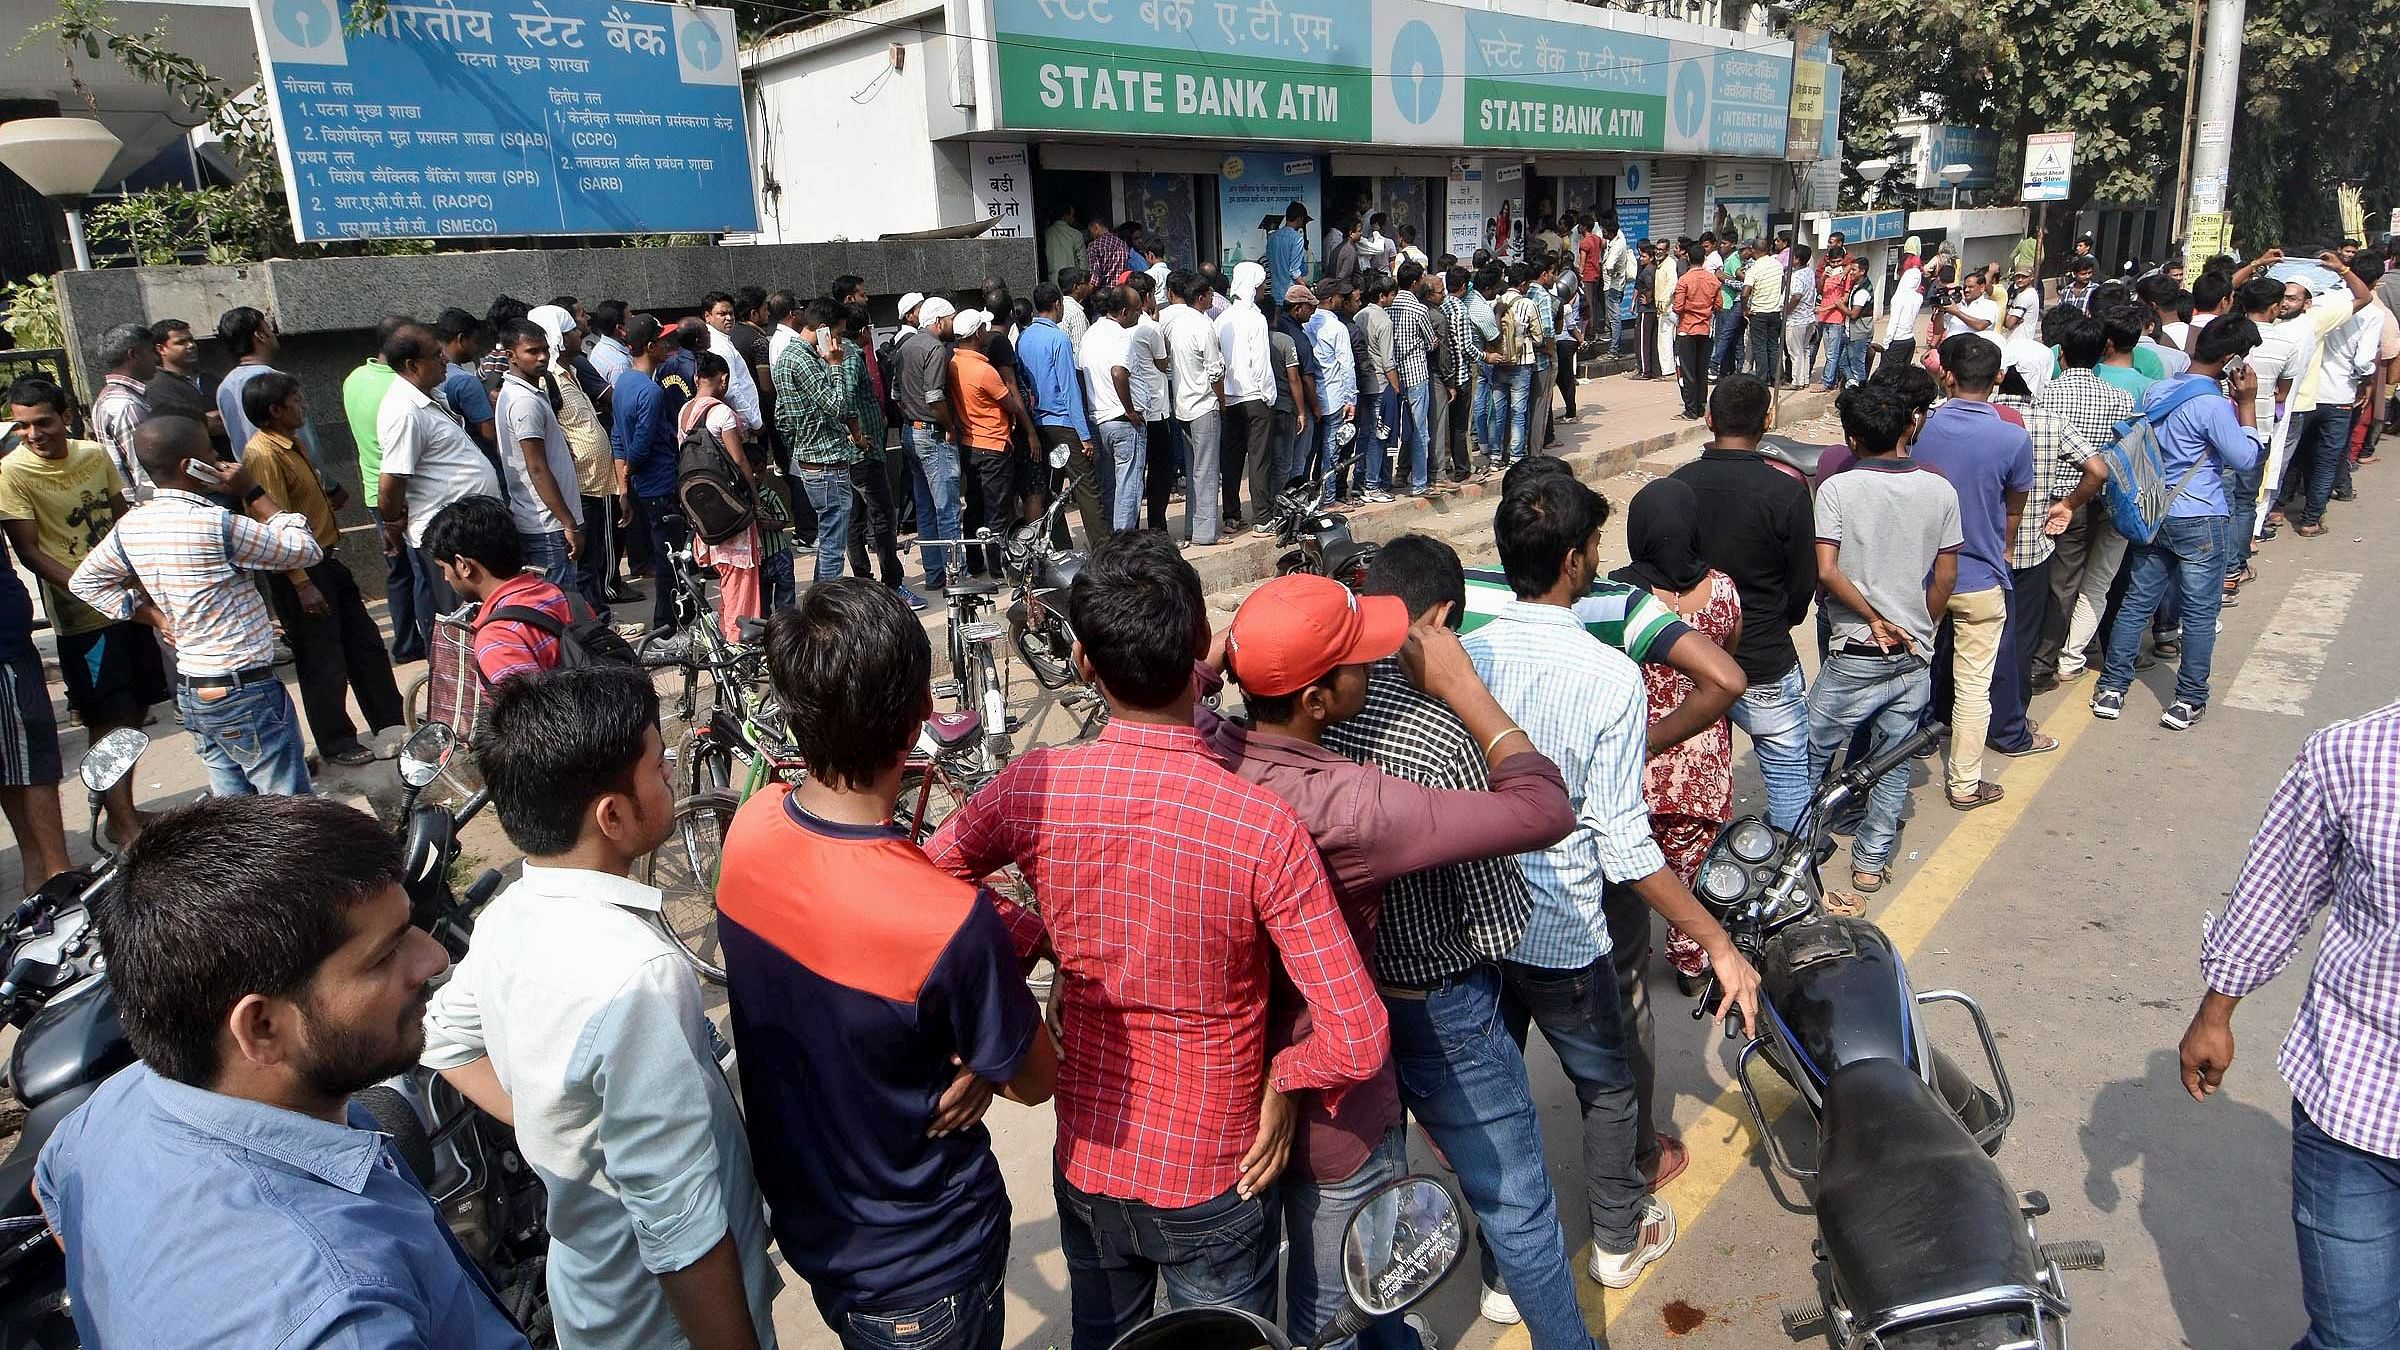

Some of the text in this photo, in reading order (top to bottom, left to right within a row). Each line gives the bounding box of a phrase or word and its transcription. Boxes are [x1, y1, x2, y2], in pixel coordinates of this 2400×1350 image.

[367, 0, 666, 56] ारतीय स्टेट बैंक
[1479, 28, 1524, 69] स्टेट
[1536, 35, 1567, 73] बैंक
[456, 51, 590, 74] पटना मुख्य शाखा
[282, 76, 354, 96] नीचला तल
[1039, 64, 1339, 122] STATE BANK ATM
[548, 87, 602, 105] द्वितीय तल
[299, 103, 422, 122] 1. पटना मुख्य शाखा
[1480, 99, 1644, 137] STATE BANK ATM
[1723, 111, 1761, 128] INTERNET
[304, 127, 318, 141] 2.
[321, 125, 383, 149] विशेषीकृत
[387, 131, 410, 148] मुद्रा
[416, 131, 458, 145] प्रशासन
[464, 132, 495, 146] शाखा
[572, 133, 617, 149] (CCPC)
[1721, 131, 1776, 149] COIN VENDING
[296, 151, 355, 165] प्रथम तल
[561, 157, 573, 170] 2.
[625, 154, 650, 170] अस्ति
[654, 155, 684, 171] प्रबंधन
[687, 158, 713, 171] शाखा
[307, 173, 321, 187] 1.
[328, 166, 365, 184] विशेष
[466, 171, 496, 184] शाखा
[503, 170, 539, 187] (SPB)
[579, 177, 623, 193] (SARB)
[311, 197, 326, 211] 2.
[433, 195, 493, 211] (RACPC)
[987, 198, 1020, 217] हो तो
[316, 221, 330, 236] 3.
[436, 219, 498, 235] (SMECC)
[19, 1227, 52, 1251] 150
[1379, 1268, 1400, 1291] OBJECTS
[1412, 1238, 1433, 1259] MIRROR
[1430, 1230, 1442, 1243] ARE
[1383, 1237, 1448, 1299] CLOSER THAN THEY APPEAR
